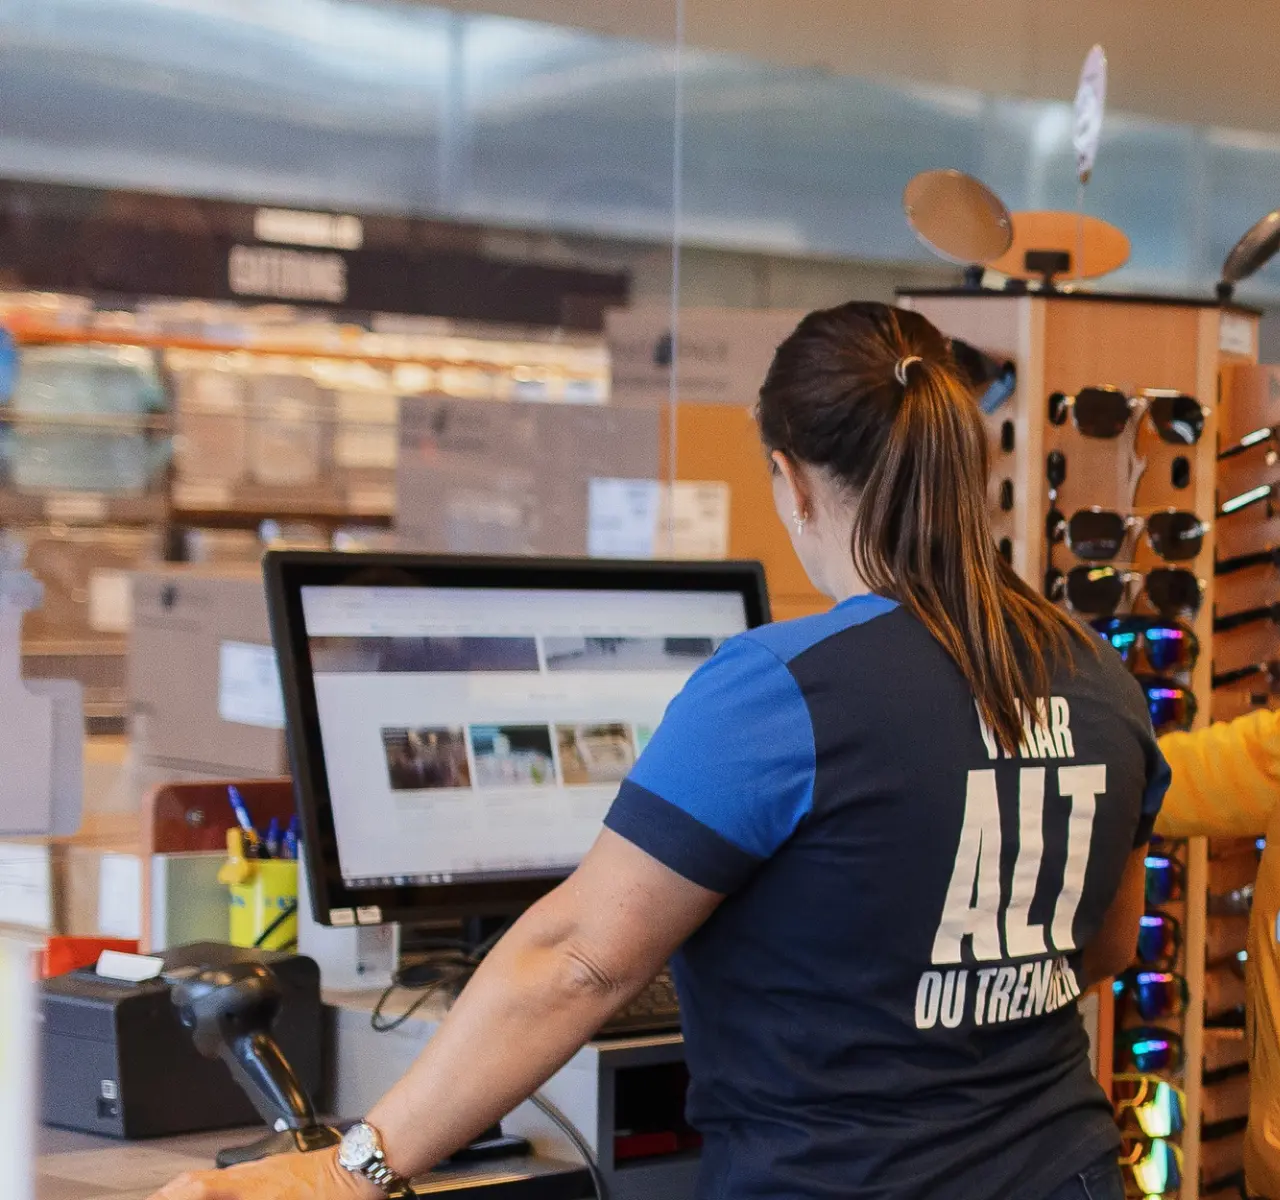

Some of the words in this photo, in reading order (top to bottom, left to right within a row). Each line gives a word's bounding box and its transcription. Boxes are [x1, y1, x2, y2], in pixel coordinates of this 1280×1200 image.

[1014, 696, 1075, 759] HAR
[931, 763, 1107, 965] ALT
[915, 970, 969, 1029] DU
